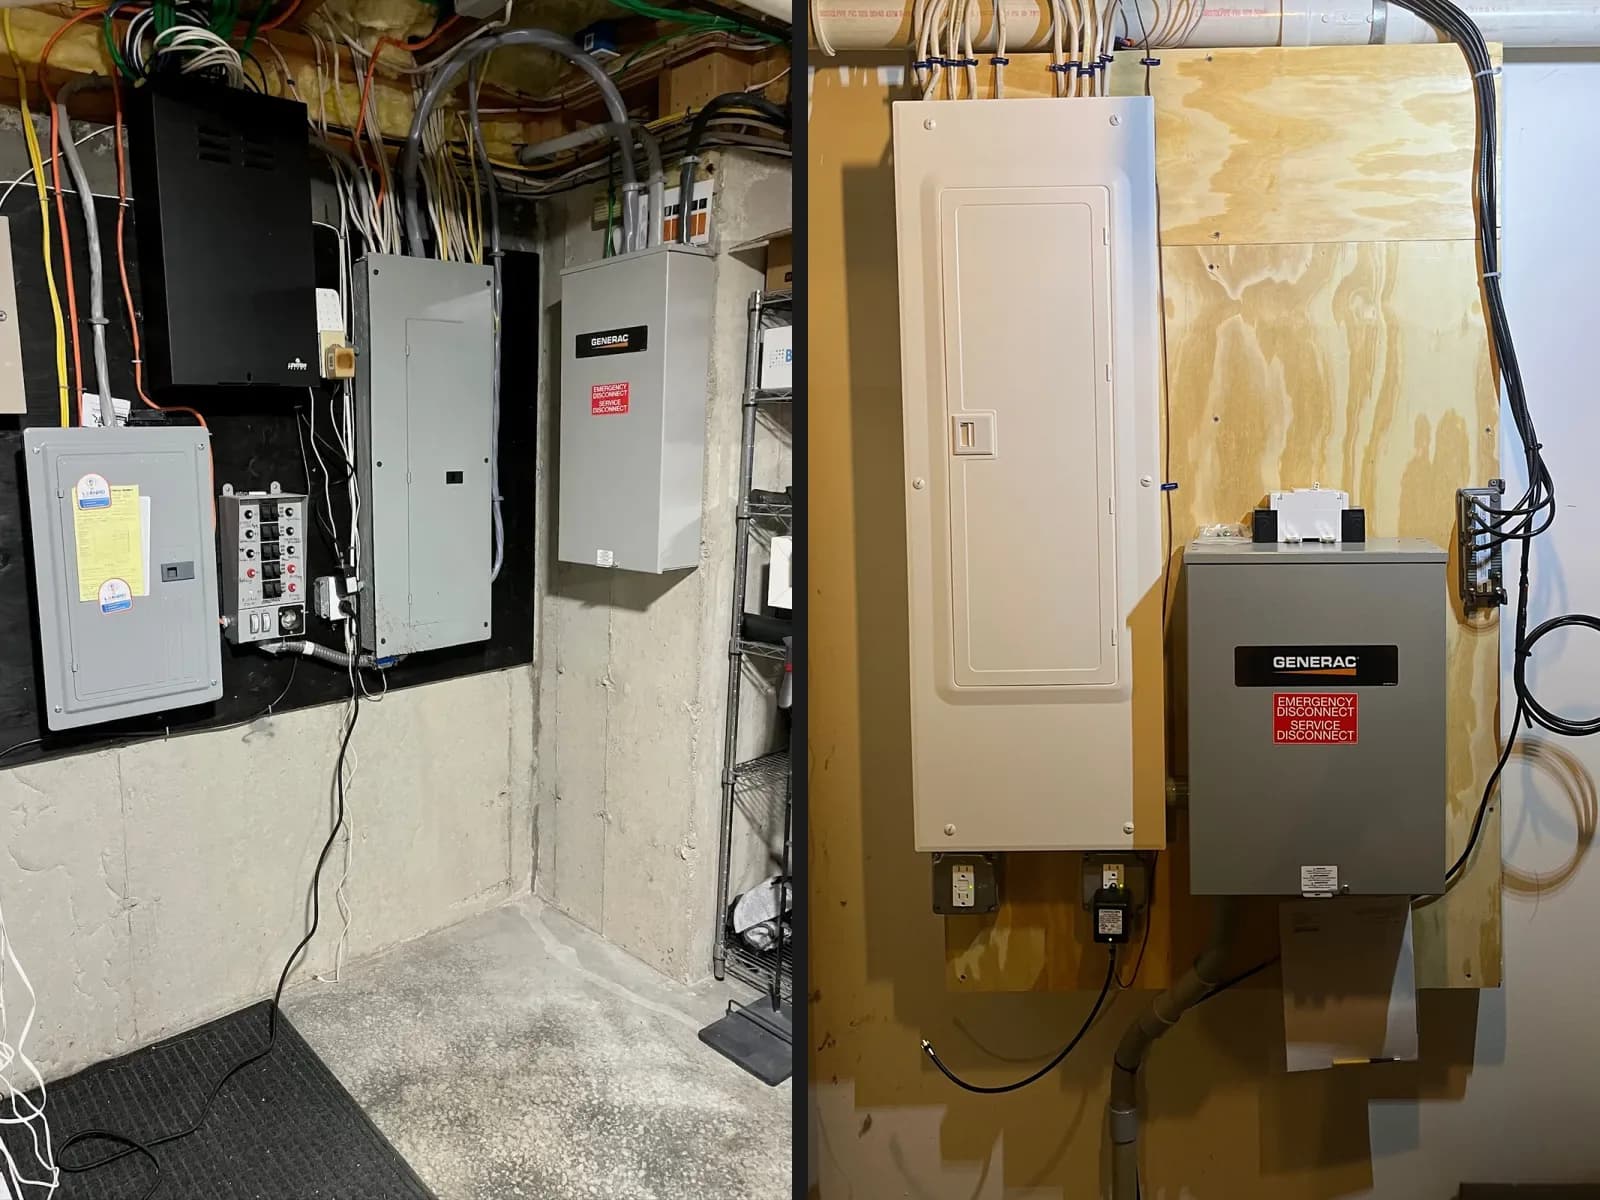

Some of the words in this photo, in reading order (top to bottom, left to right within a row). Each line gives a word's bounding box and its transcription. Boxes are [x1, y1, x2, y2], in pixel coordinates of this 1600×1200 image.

[591, 334, 630, 346] GENERAC
[593, 384, 627, 393] EMERGENCY
[592, 390, 628, 399] DISCONNECT
[592, 405, 628, 414] DISCONNECT
[1273, 656, 1357, 668] GENERAC
[1278, 697, 1353, 707] EMERGENCY
[1277, 707, 1355, 717] DISCONNECT
[1290, 720, 1341, 730] SERVICE
[1277, 730, 1355, 741] DISCONNECT
